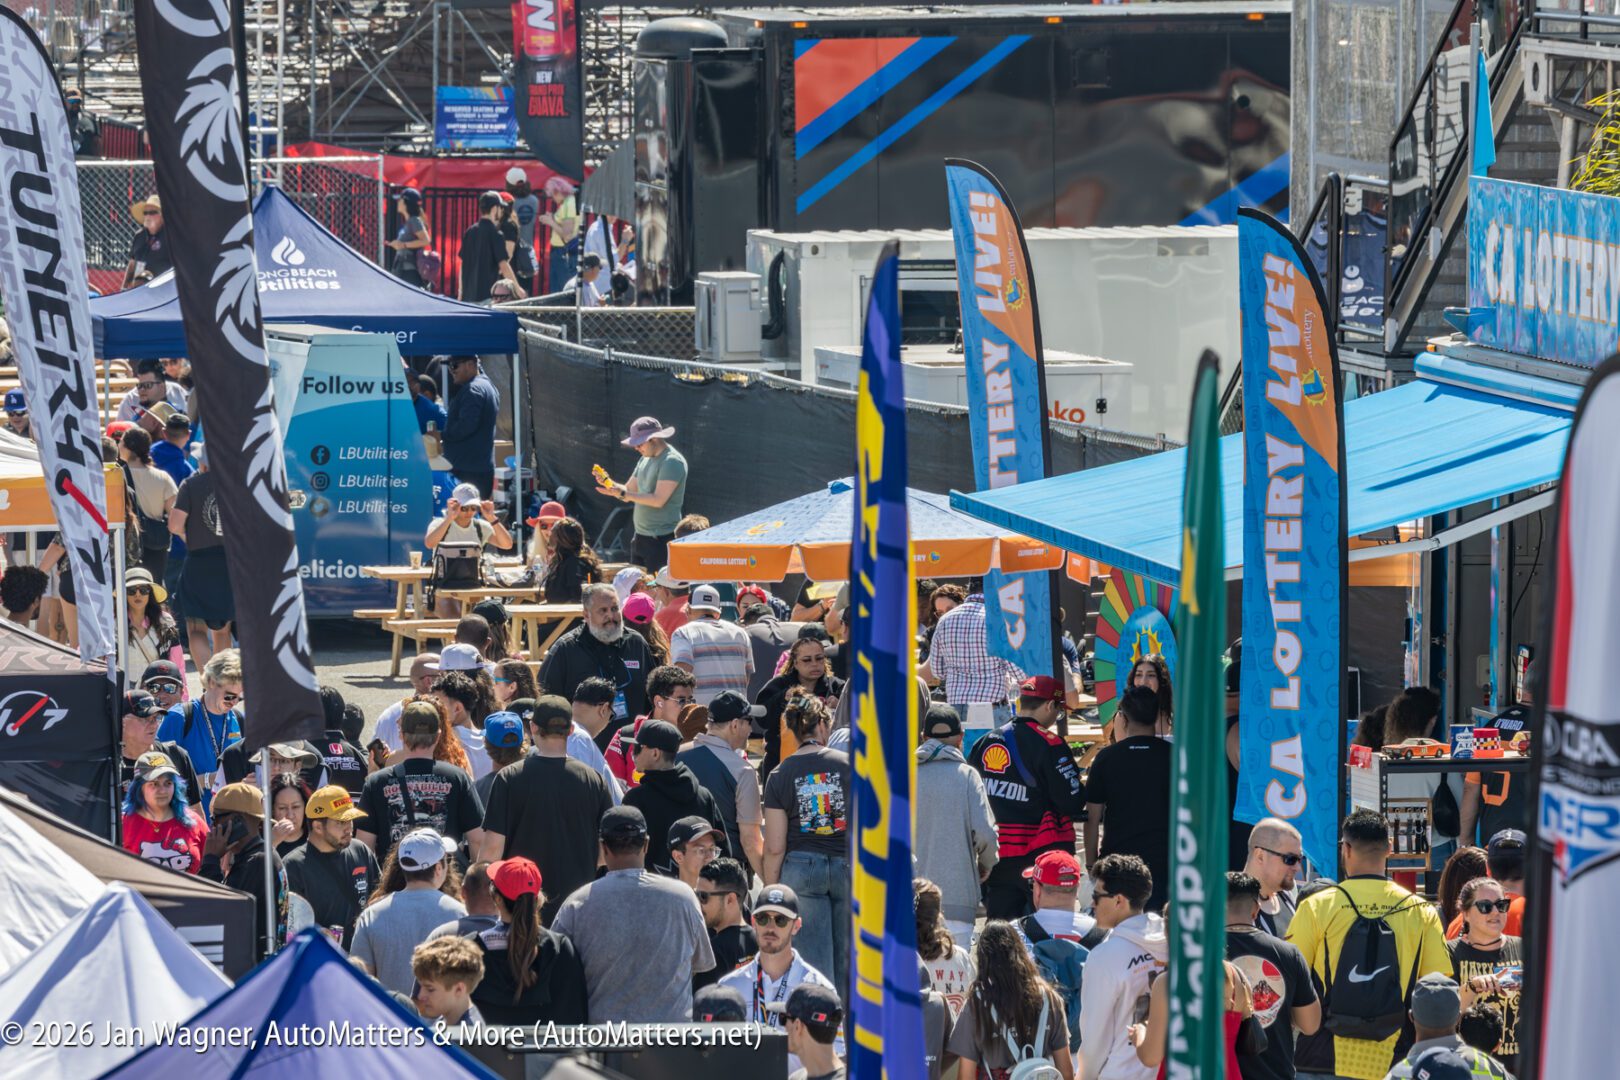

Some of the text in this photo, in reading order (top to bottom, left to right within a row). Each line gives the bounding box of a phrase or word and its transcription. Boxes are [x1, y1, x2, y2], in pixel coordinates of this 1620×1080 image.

[536, 71, 553, 84] NEW
[528, 96, 565, 117] GUAVA
[1486, 218, 1620, 328] CA LOTTERY
[303, 375, 405, 394] Follow us
[969, 190, 1026, 650] CA TTERY LIVE!
[339, 447, 409, 460] LBUtilities
[338, 474, 409, 488] LBUtilities
[1262, 252, 1308, 820] CA LOTTERY LIVE!
[982, 777, 1030, 802] NZOIL
